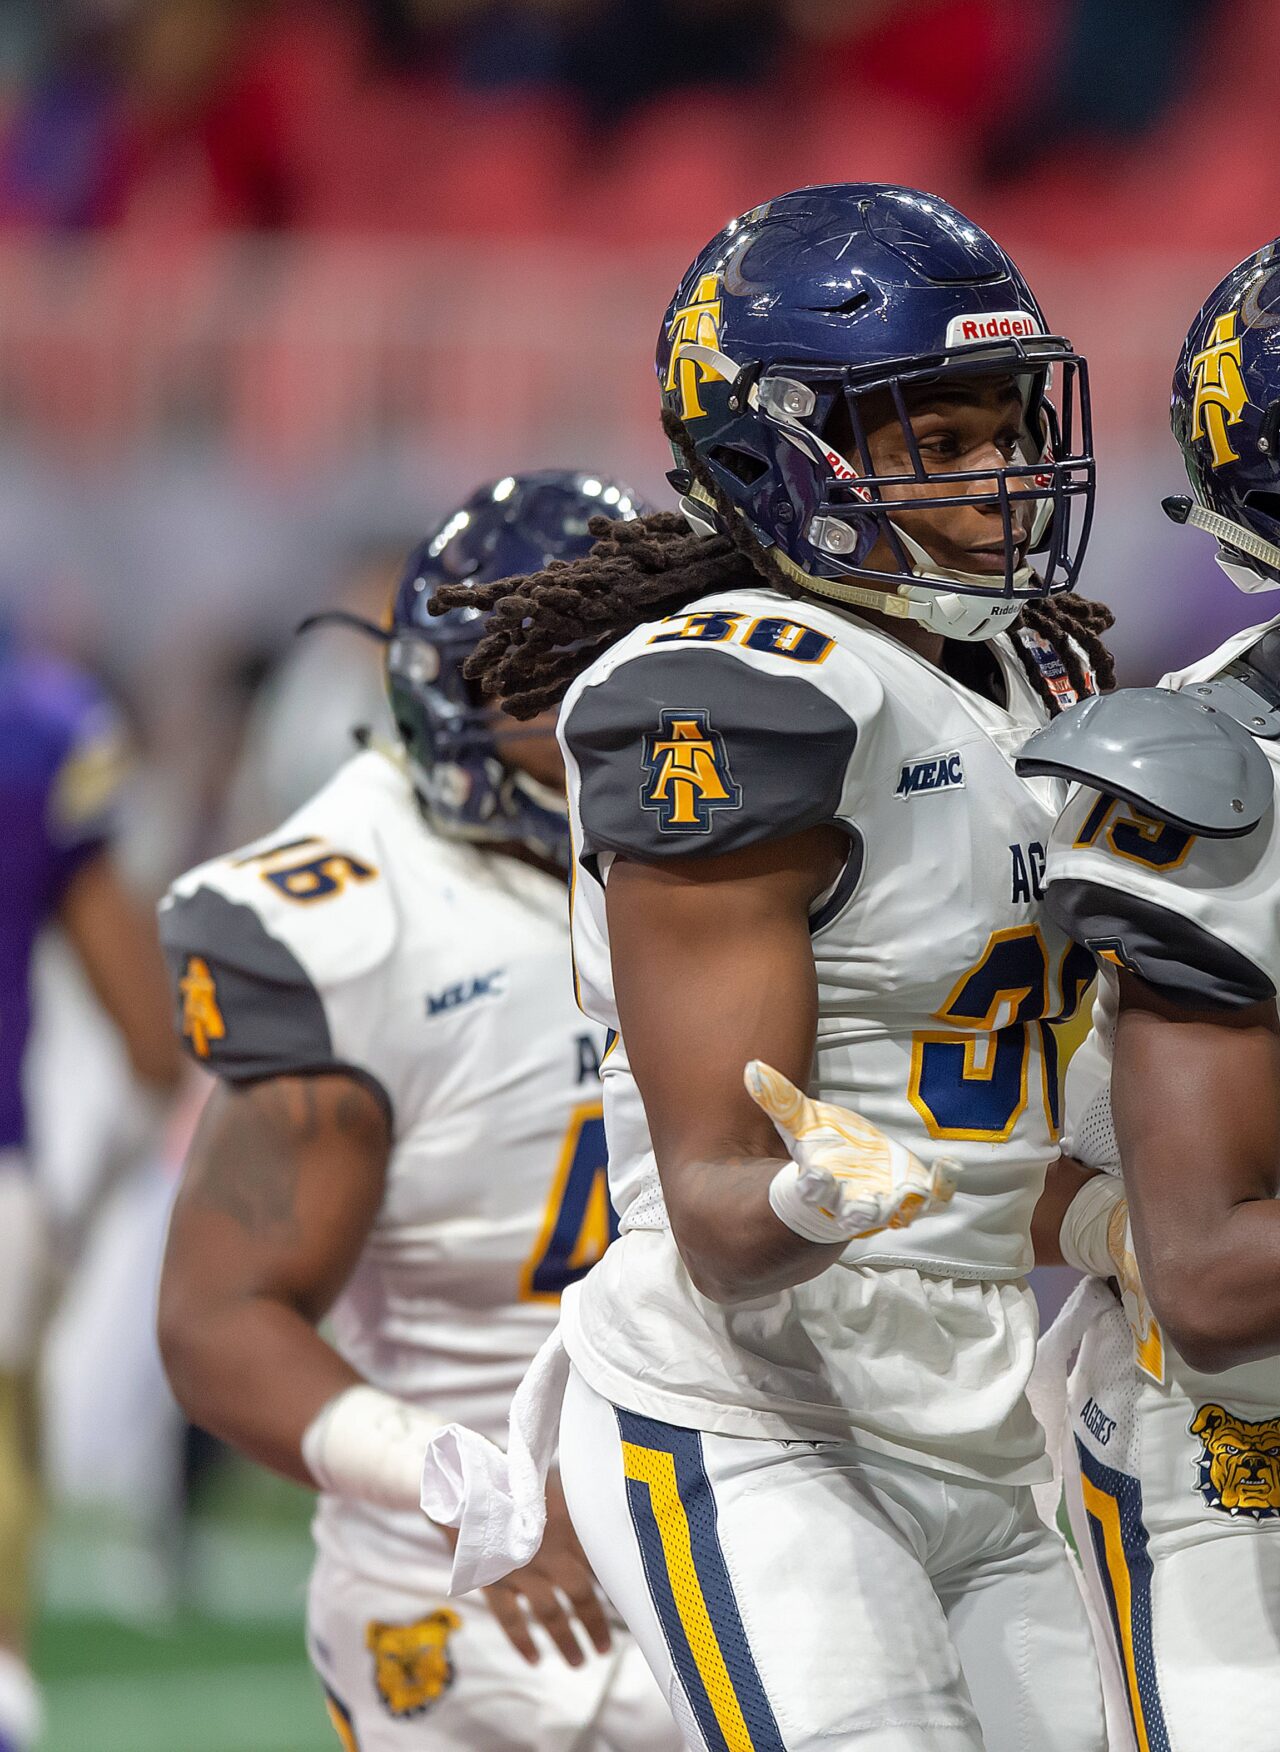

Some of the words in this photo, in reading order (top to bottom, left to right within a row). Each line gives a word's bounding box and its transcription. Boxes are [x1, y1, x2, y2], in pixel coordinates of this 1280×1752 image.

[962, 318, 1034, 340] Riddell
[646, 611, 839, 665] 30
[895, 755, 963, 797] MEAC
[1080, 1396, 1117, 1447] AGGIES
